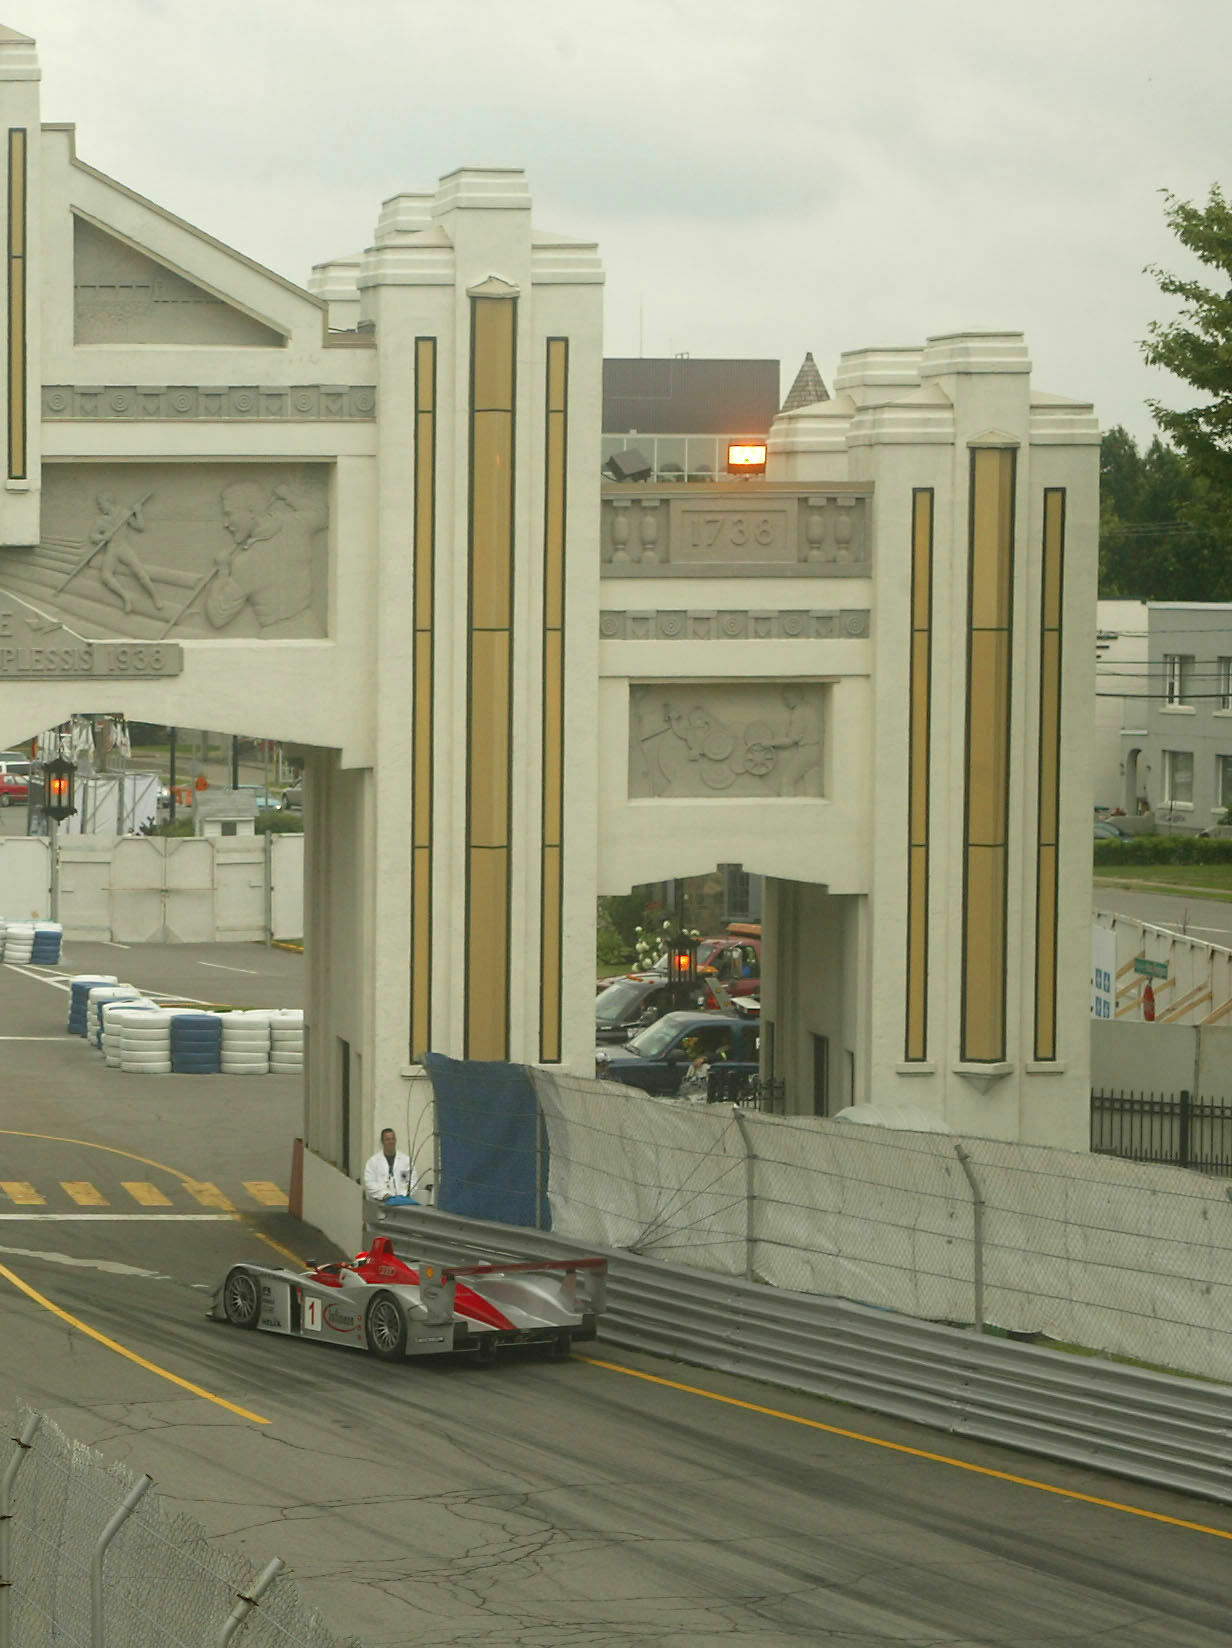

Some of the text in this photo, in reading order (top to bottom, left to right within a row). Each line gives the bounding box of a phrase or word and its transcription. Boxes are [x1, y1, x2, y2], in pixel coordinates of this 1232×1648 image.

[690, 518, 776, 548] 1738
[107, 646, 166, 674] 1938
[308, 1301, 316, 1326] 1
